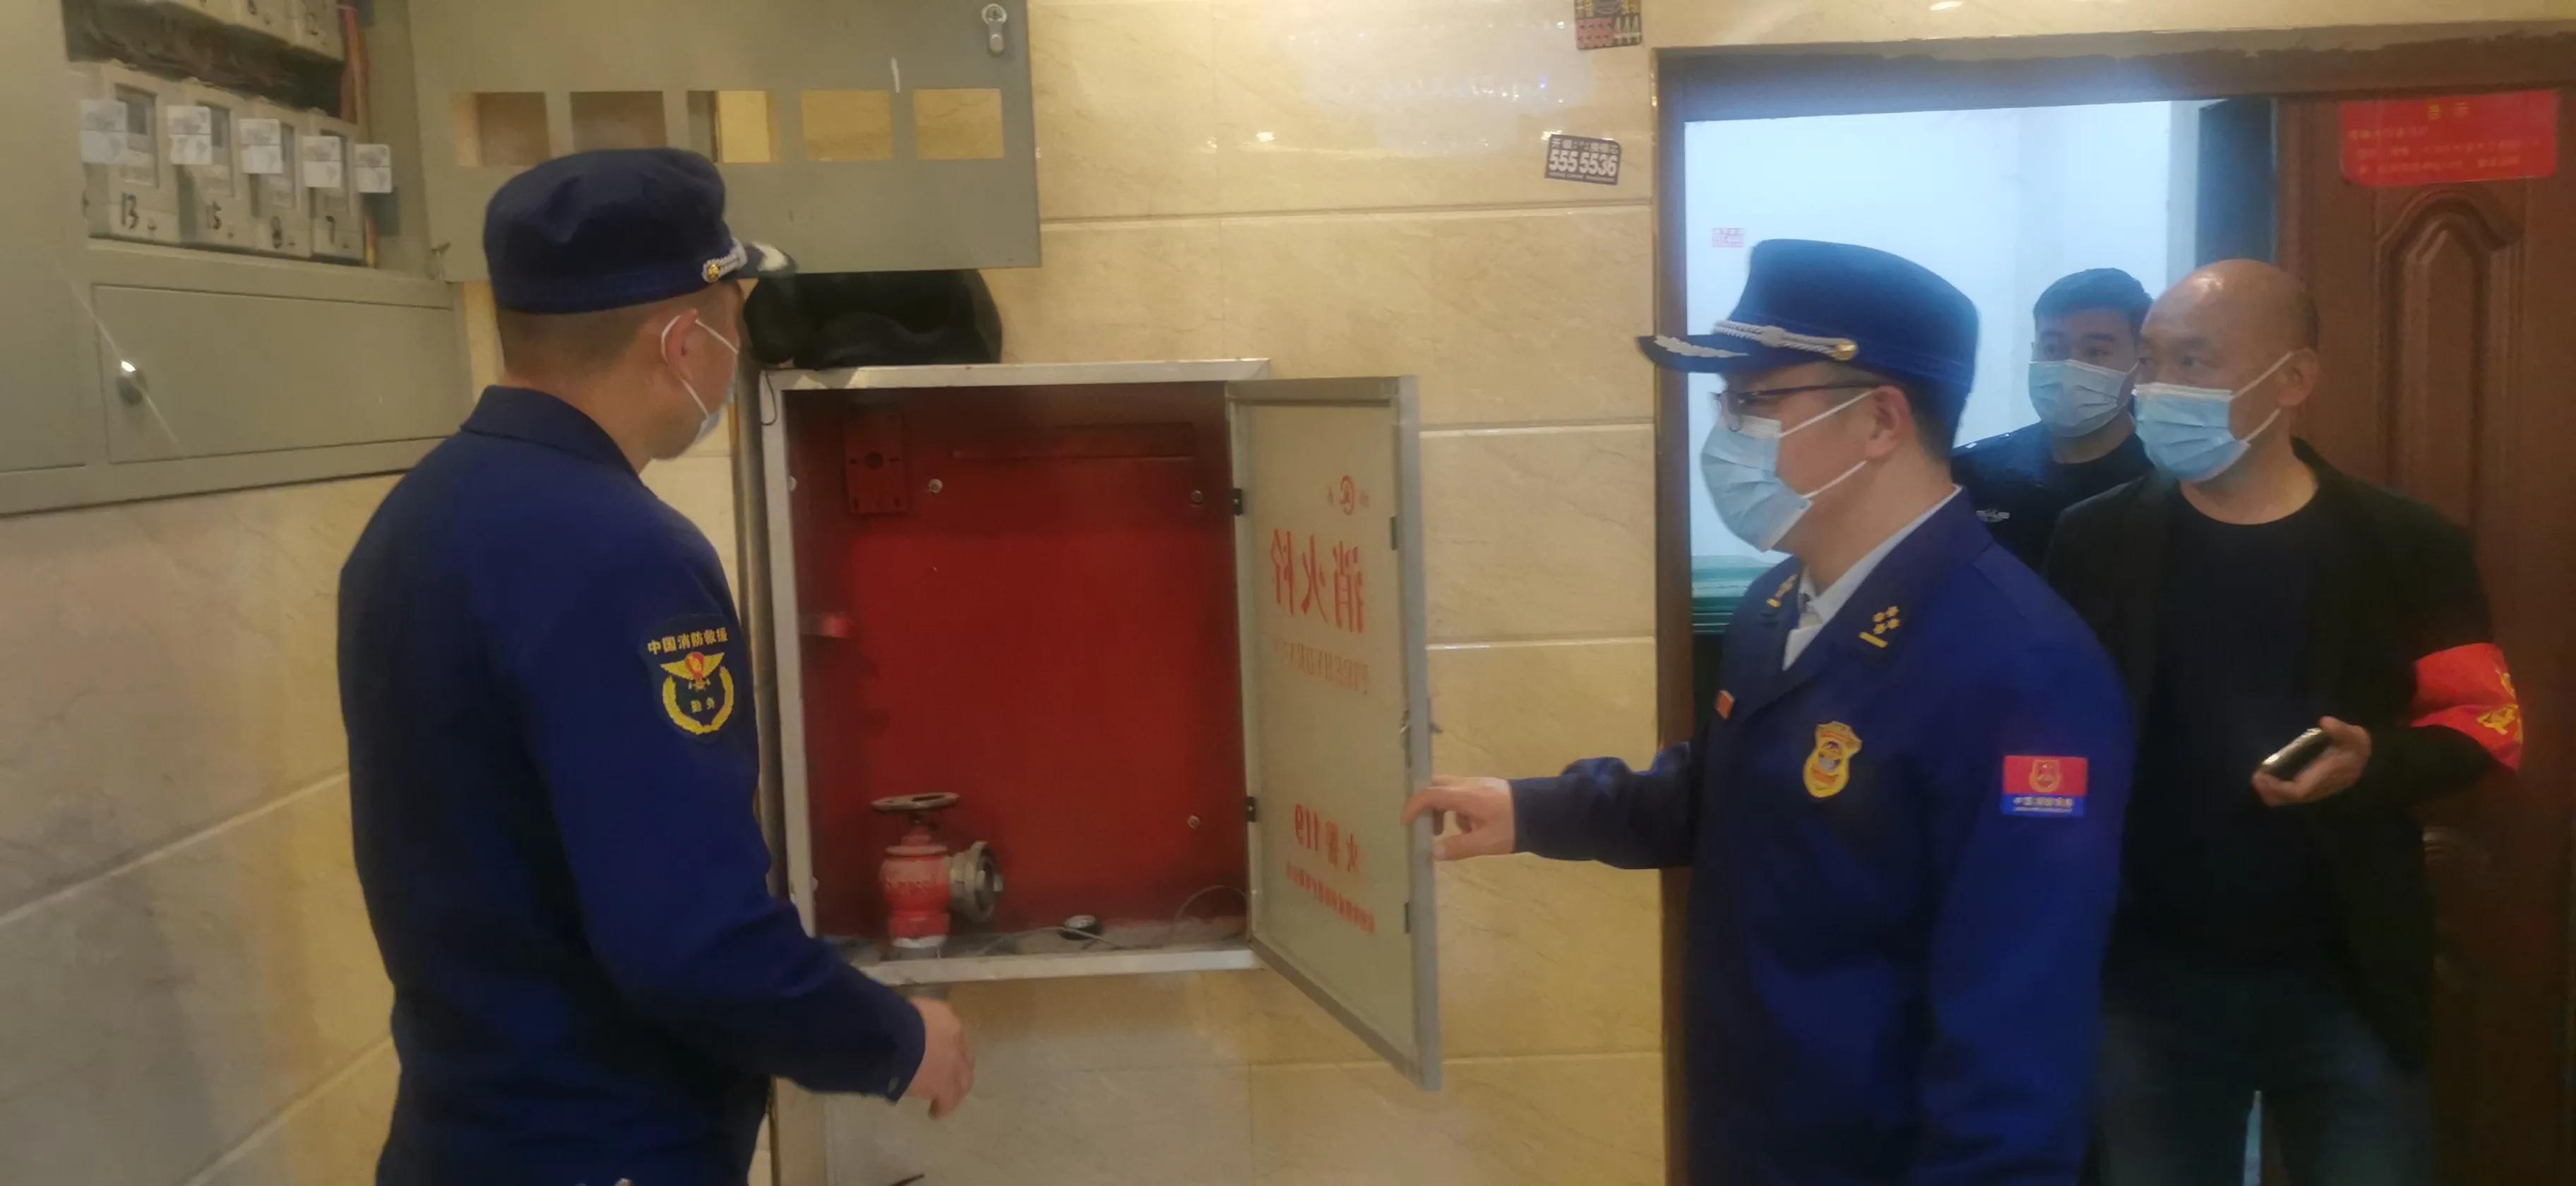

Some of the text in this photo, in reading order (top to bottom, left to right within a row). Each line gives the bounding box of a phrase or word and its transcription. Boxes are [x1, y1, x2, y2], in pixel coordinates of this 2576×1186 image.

[1549, 149, 1618, 176] 555 5536
[647, 628, 728, 654] 中国消防救援
